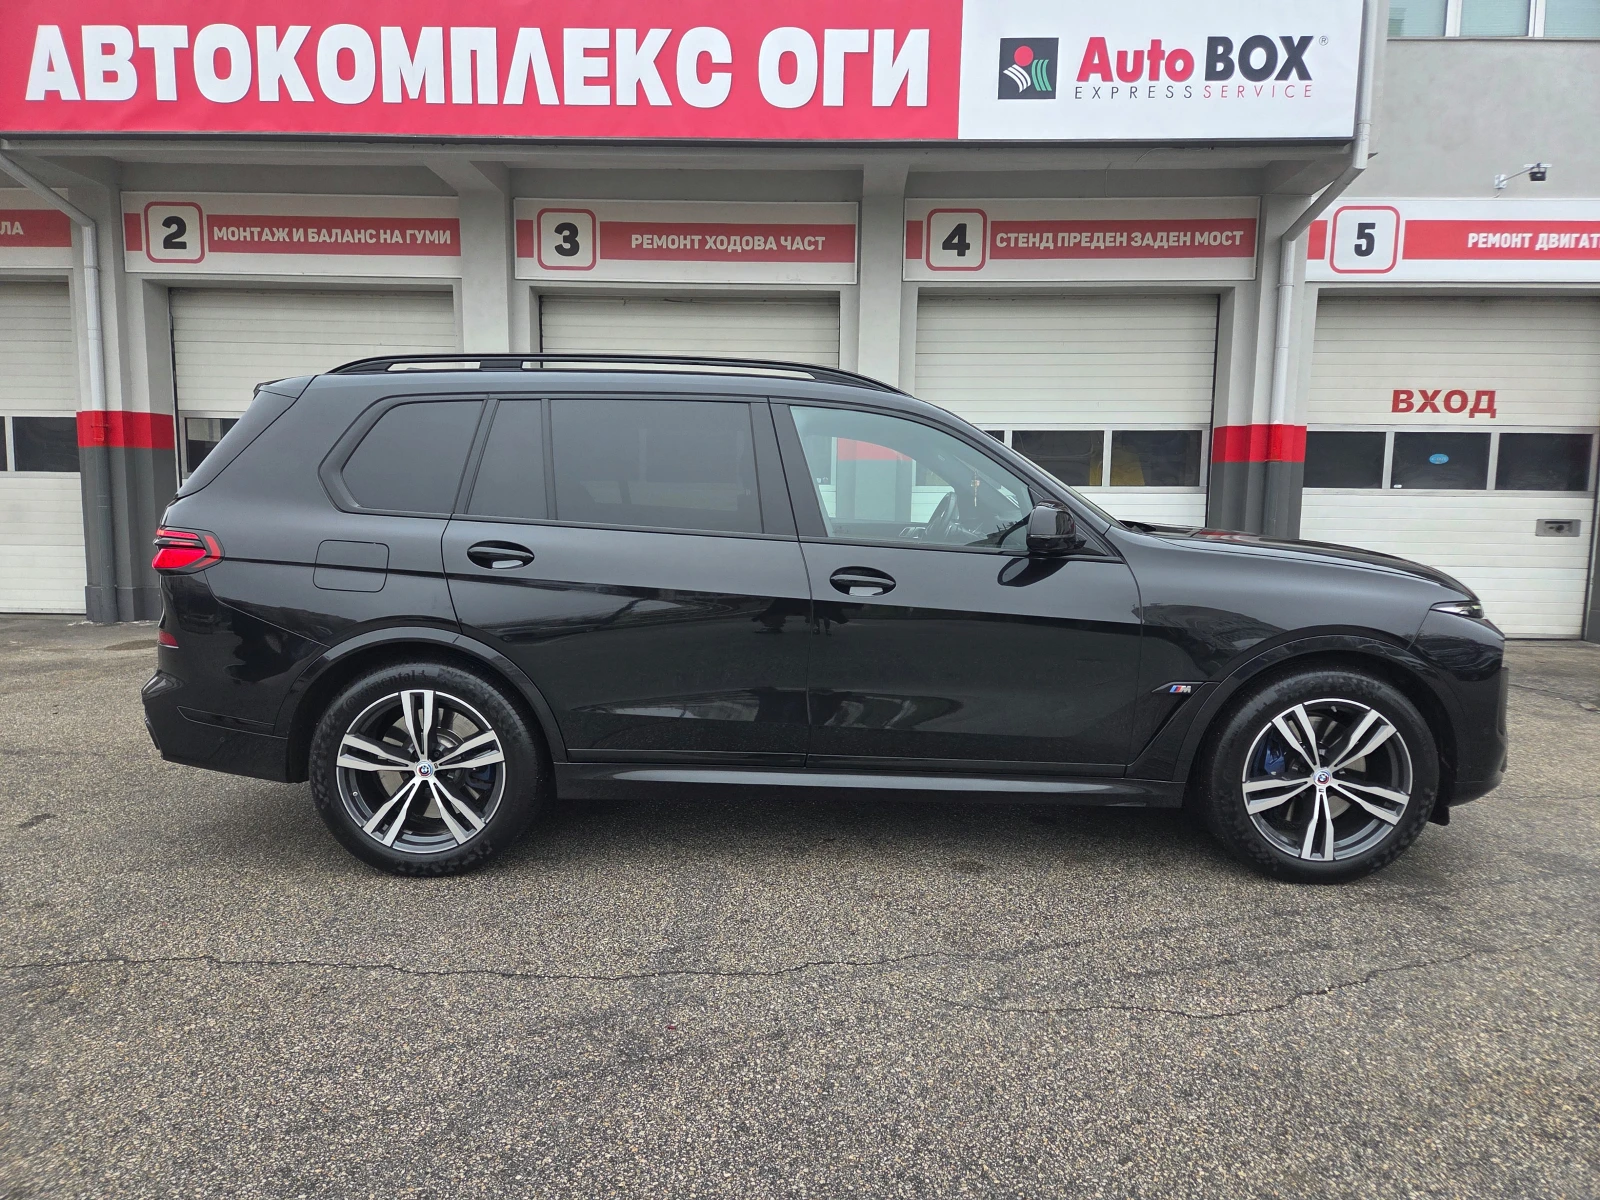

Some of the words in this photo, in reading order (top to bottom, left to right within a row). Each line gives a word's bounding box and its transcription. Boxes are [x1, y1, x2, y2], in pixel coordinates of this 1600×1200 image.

[25, 24, 732, 108] АВТОКОМПЛЕКС
[758, 27, 929, 108] ОГИ
[1076, 36, 1195, 83] Auto
[1204, 34, 1314, 82] BOX
[1074, 85, 1193, 100] EXPRESS
[1203, 84, 1313, 99] SERVICE
[162, 216, 187, 249] 2
[213, 226, 290, 242] МОНТАЖ
[292, 228, 304, 242] И
[307, 228, 377, 244] БАЛАНС
[379, 229, 403, 244] НА
[406, 229, 451, 244] ГУМИ
[554, 222, 580, 257] 3
[631, 234, 702, 250] РЕМОНТ
[704, 235, 777, 253] ХОДОВА
[780, 236, 826, 251] ЧАСТ
[941, 223, 970, 257] 4
[995, 233, 1054, 250] СТЕНД
[1057, 232, 1127, 250] ПРЕДЕН
[1131, 231, 1191, 249] ЗАДЕН
[1195, 230, 1244, 246] МОСТ
[1354, 222, 1376, 257] 5
[1467, 232, 1534, 248] РЕМОНТ
[1534, 233, 1600, 251] ДВИГАТ
[1391, 389, 1496, 419] ВХОД
